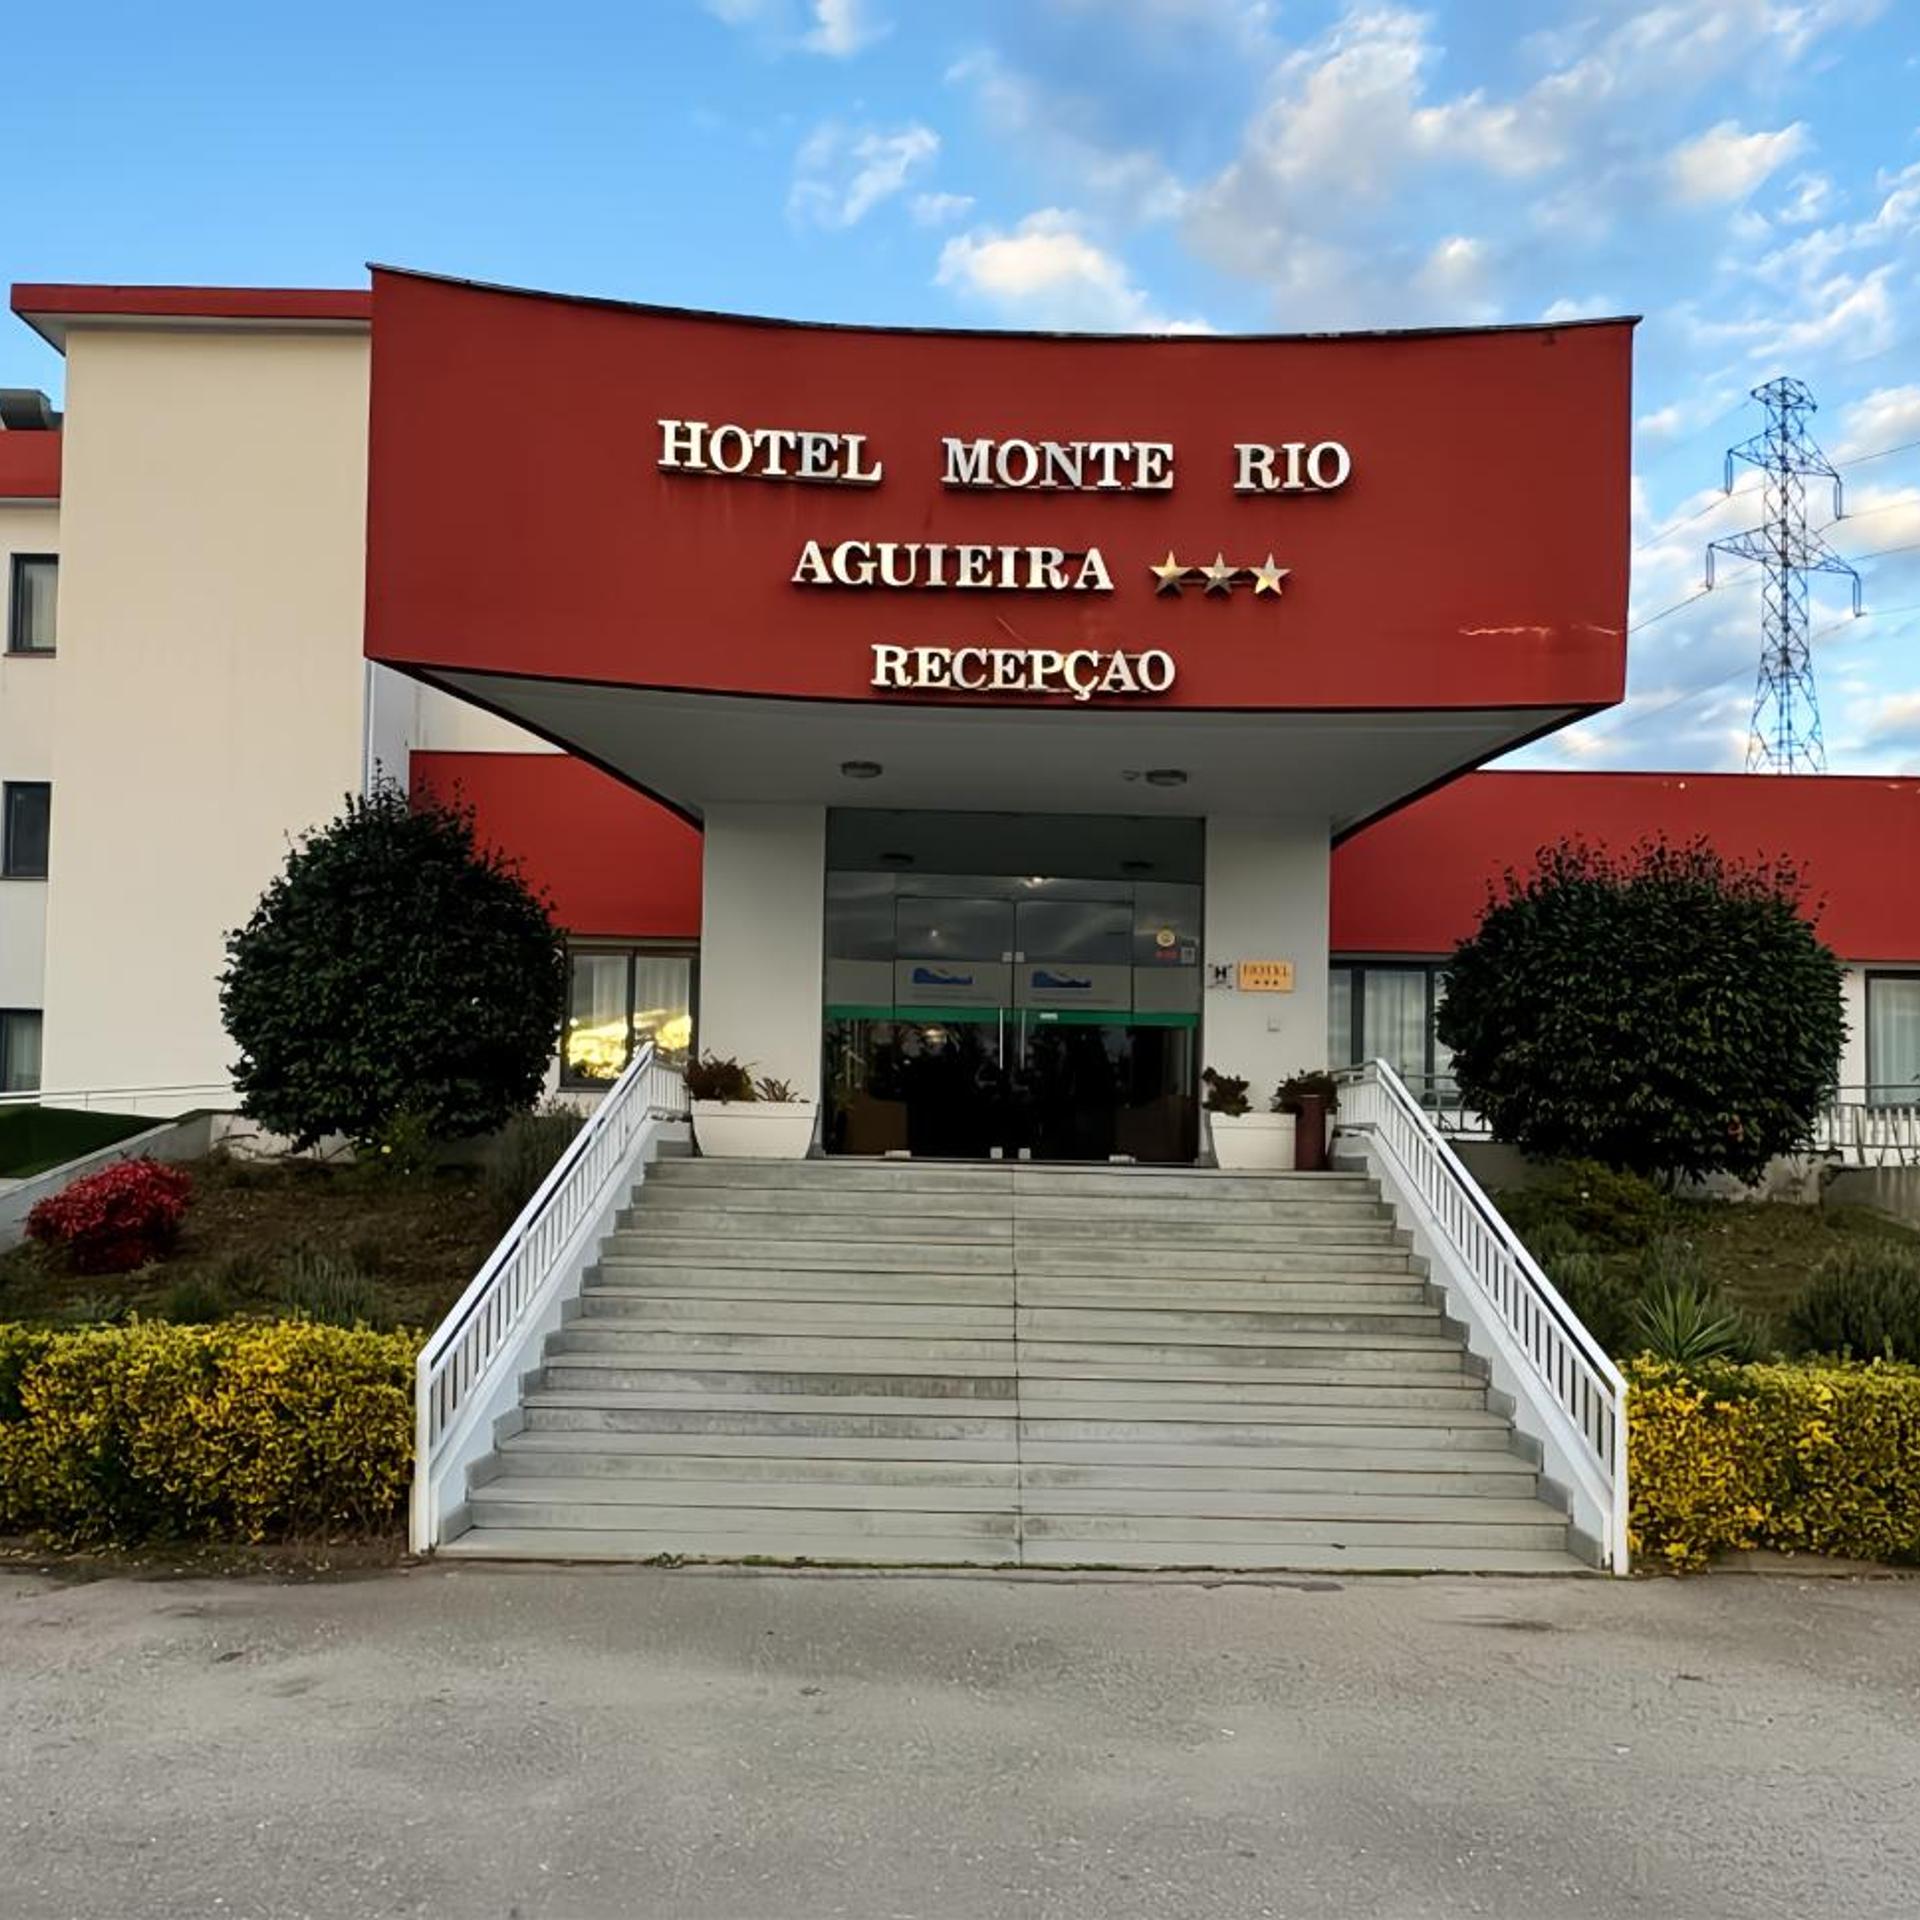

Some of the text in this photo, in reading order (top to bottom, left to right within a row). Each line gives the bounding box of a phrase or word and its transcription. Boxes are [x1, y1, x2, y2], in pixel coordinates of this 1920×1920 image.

[657, 419, 1351, 491] HOTEL MONTE RIO
[791, 540, 1114, 591] AGUIEIRA
[870, 643, 1176, 701] RECEPÇAO
